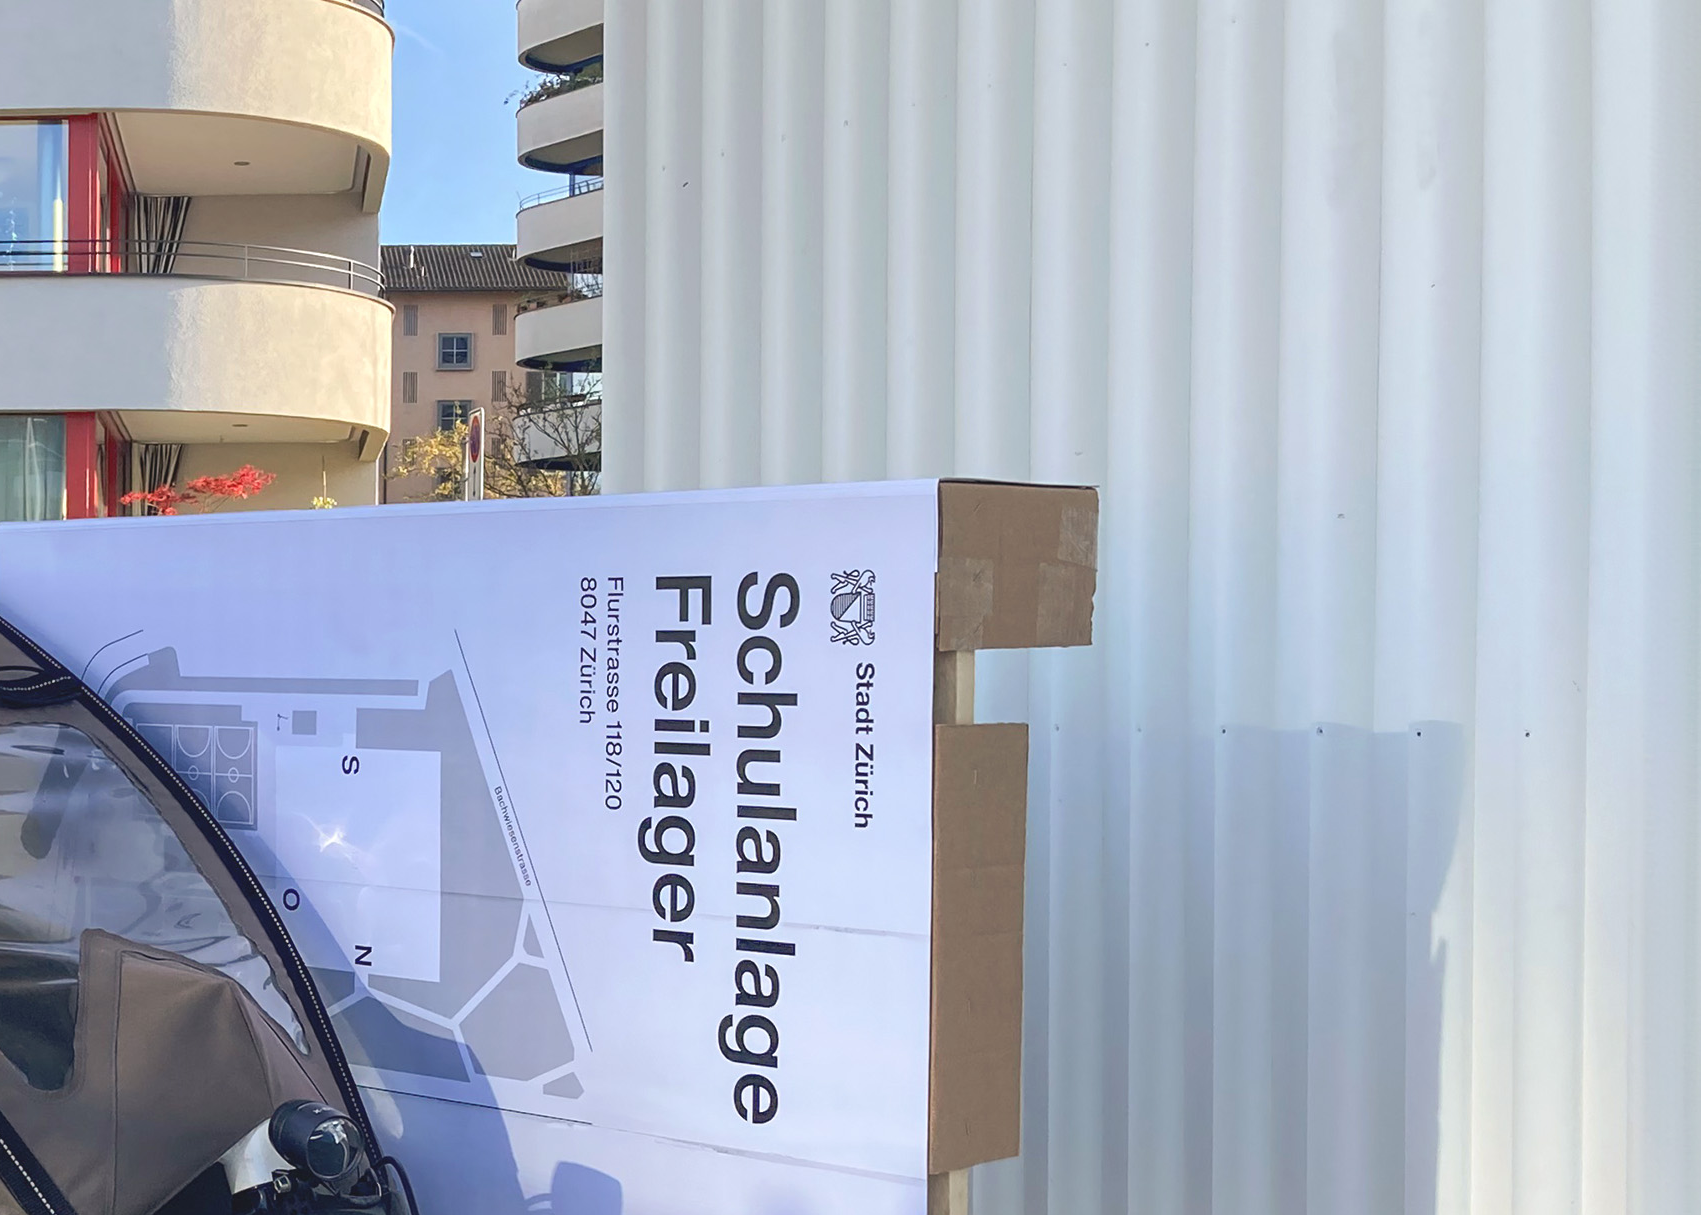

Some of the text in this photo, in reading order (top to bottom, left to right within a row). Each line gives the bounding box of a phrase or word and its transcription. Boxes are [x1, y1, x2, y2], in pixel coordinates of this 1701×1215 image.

[579, 576, 598, 724] 8047 Zürich
[604, 576, 624, 811] Flurstrasse 118/120
[341, 755, 360, 775] S
[637, 575, 712, 963] Freilager
[854, 662, 876, 829] Stadt Zürich
[282, 888, 301, 911] O
[494, 785, 532, 888] Bachwiesenstrasse
[717, 571, 801, 1125] Schulanlage
[354, 944, 373, 967] N
